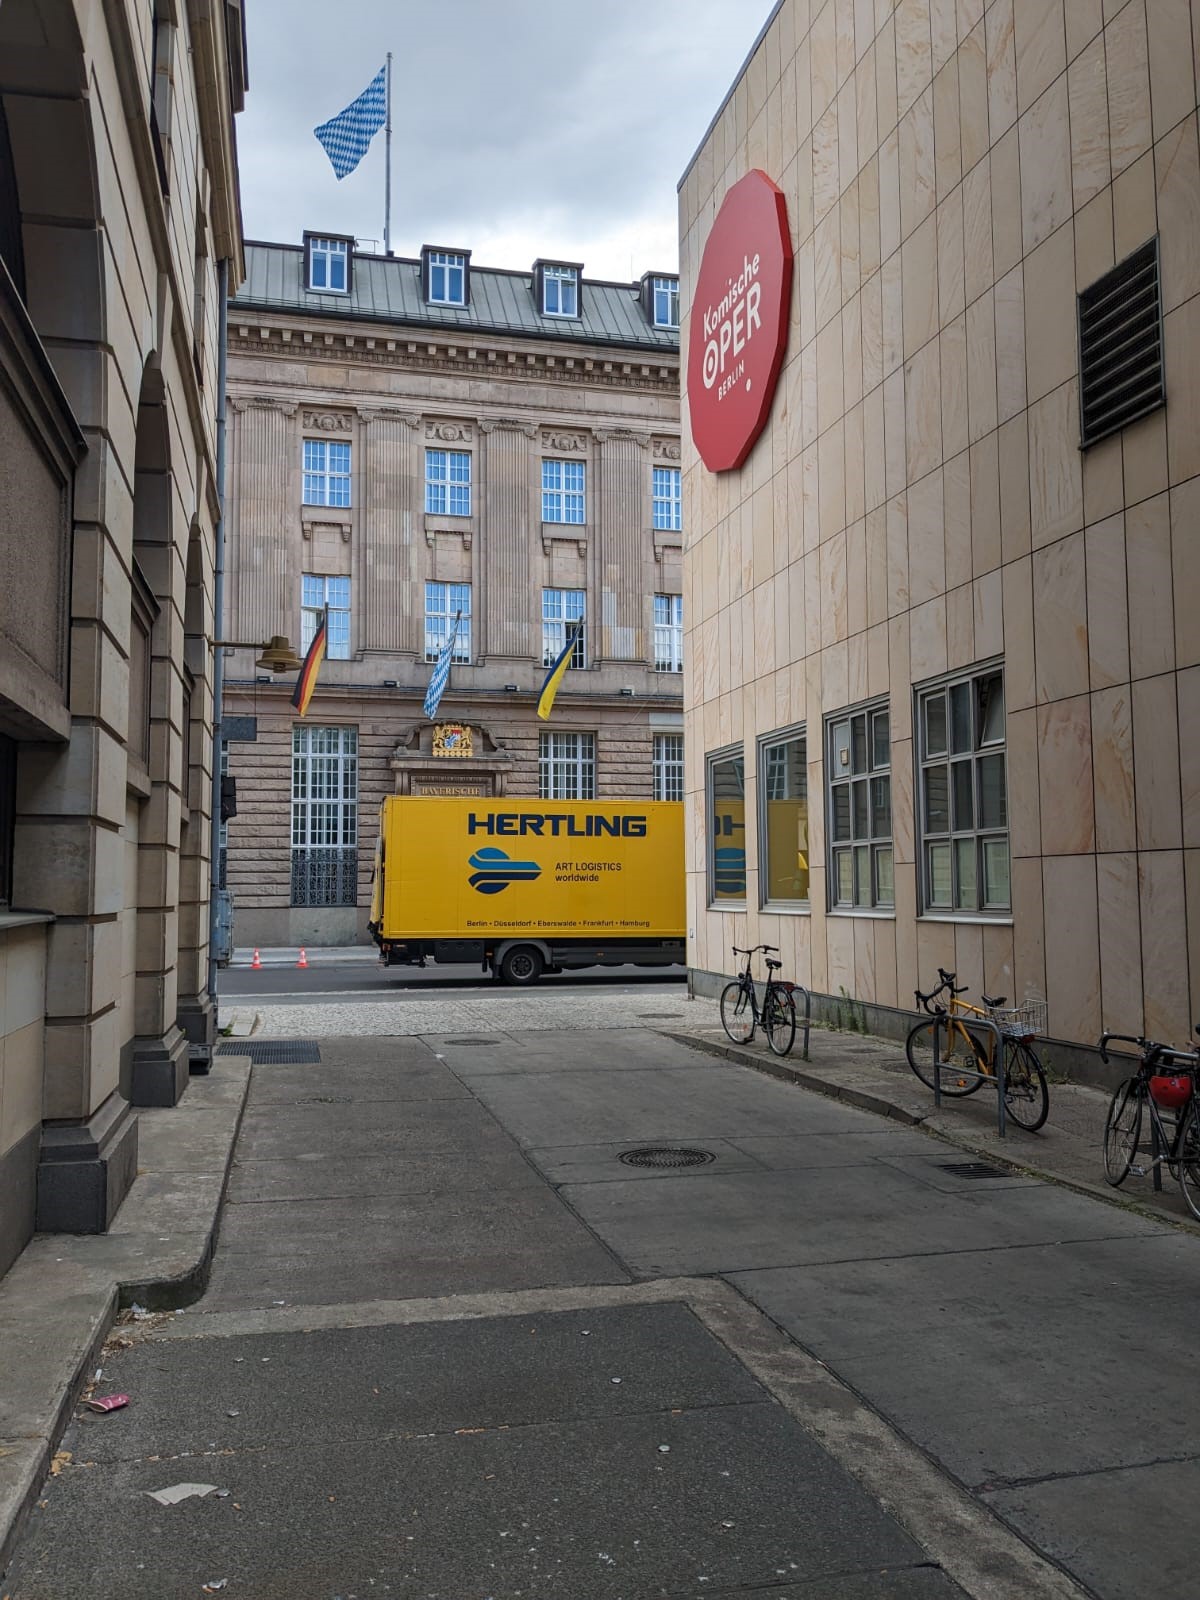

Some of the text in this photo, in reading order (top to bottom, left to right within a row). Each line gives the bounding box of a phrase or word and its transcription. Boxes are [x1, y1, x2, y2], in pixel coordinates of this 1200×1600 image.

[703, 253, 760, 342] Komische
[702, 281, 762, 389] OPER
[718, 360, 745, 401] BERLIN
[422, 787, 480, 795] BAYERISCHE
[468, 813, 647, 837] HERTLING
[555, 862, 622, 871] ART LOGISTICS
[555, 873, 599, 882] worldwide
[493, 919, 532, 927] Düsseldorf
[619, 920, 650, 928] Hamburg
